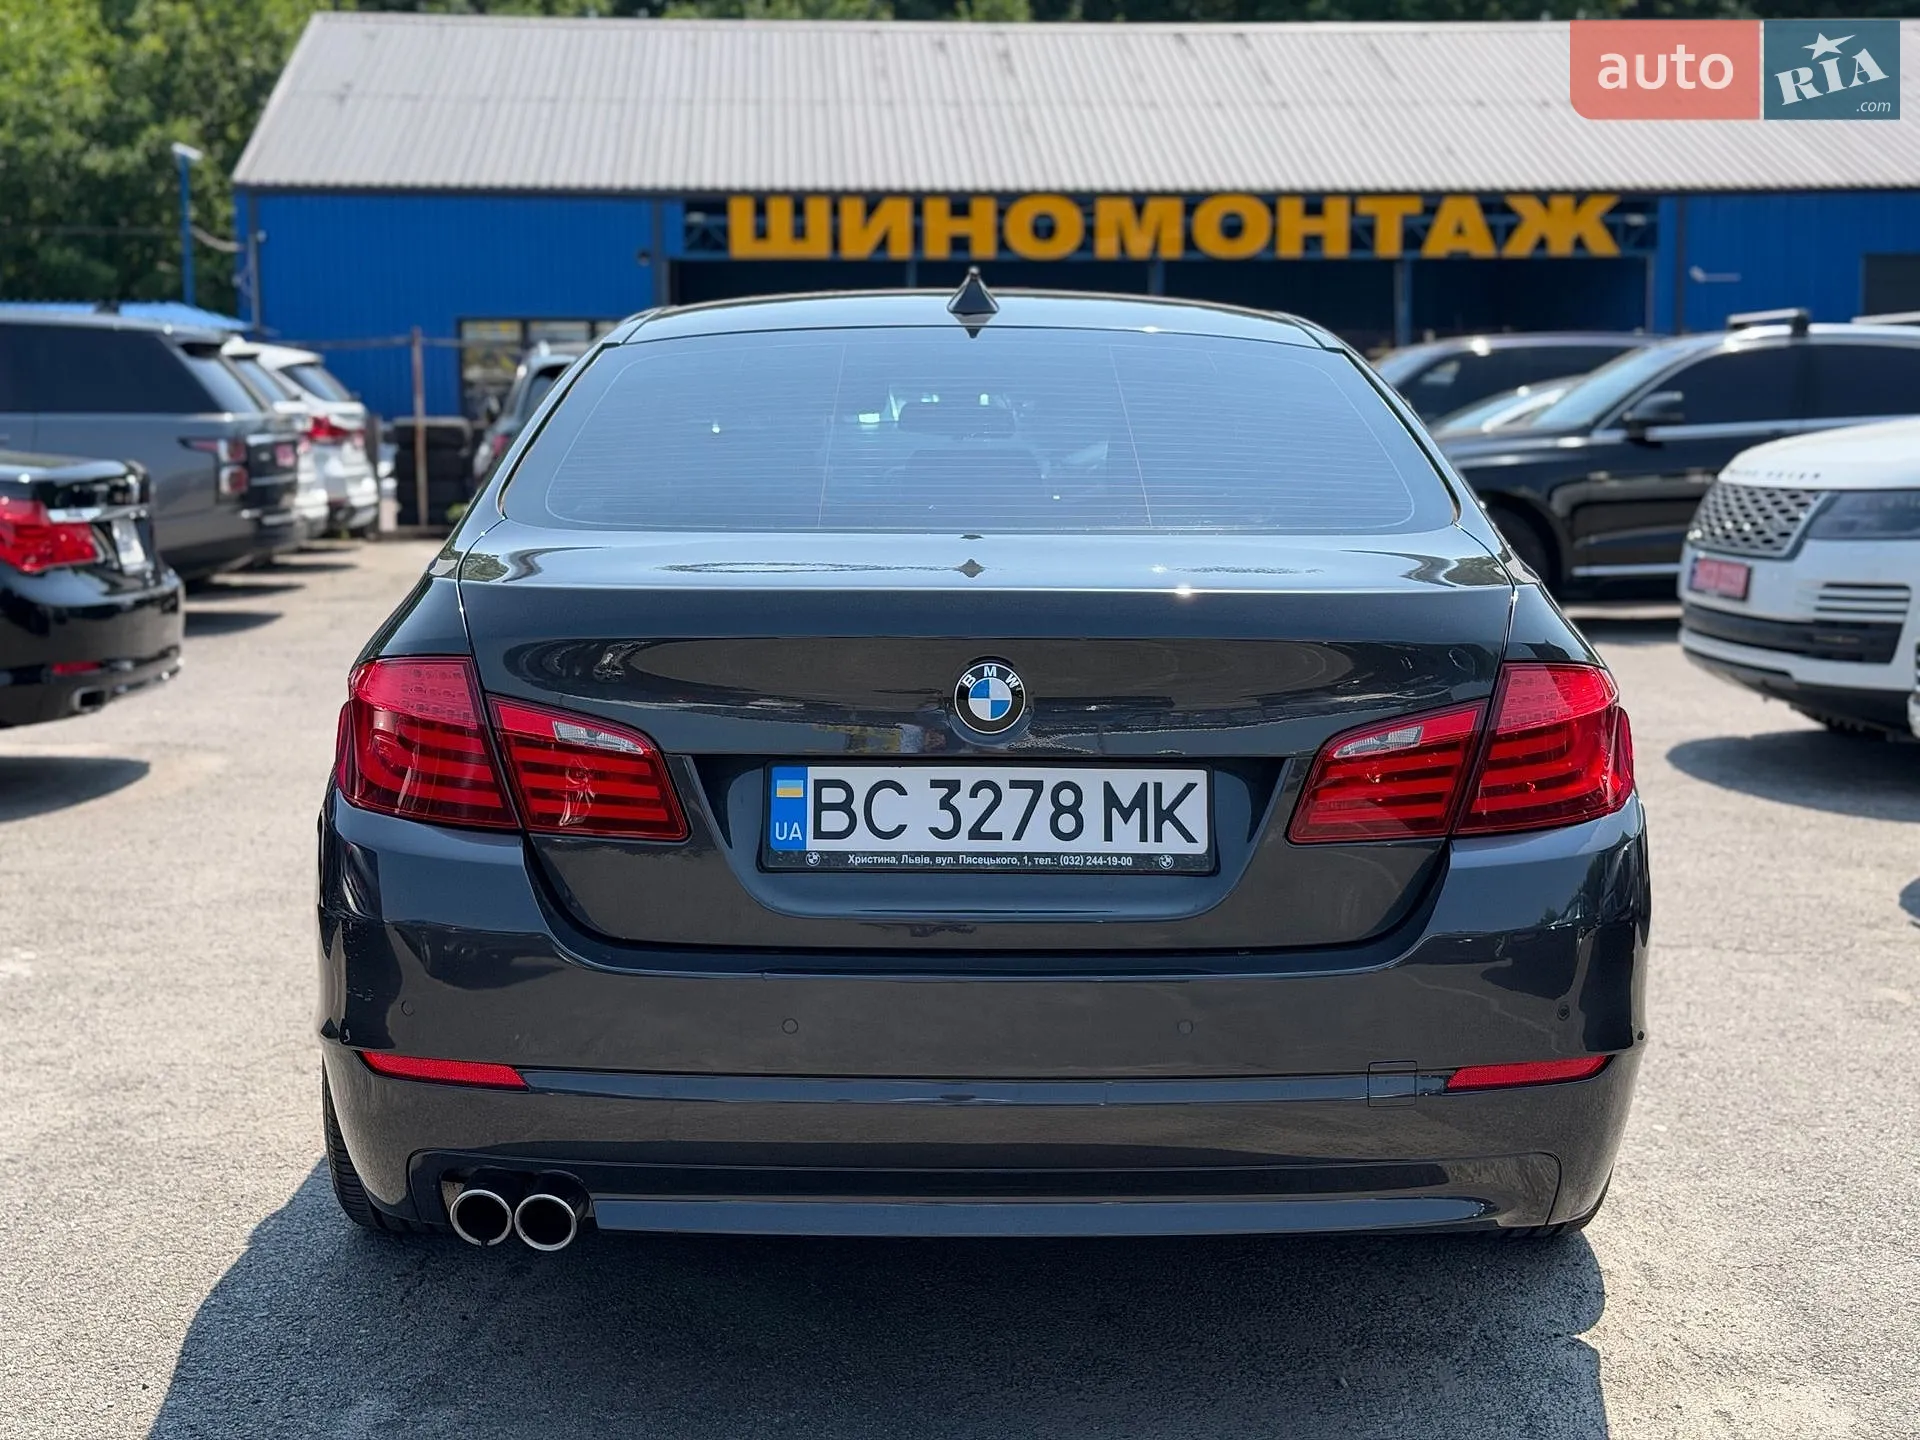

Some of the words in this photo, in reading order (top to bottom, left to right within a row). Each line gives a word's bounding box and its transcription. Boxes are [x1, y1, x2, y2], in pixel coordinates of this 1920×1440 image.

[728, 194, 1621, 260] ШИНОМОНТАЖ
[961, 665, 1020, 689] BMW
[812, 778, 908, 841] BC
[928, 779, 1085, 842] 3278
[1103, 781, 1199, 844] MK
[775, 822, 803, 841] UA
[847, 854, 899, 866] Христина,
[900, 854, 933, 866] Львів,
[935, 857, 956, 866] вул.
[959, 855, 1020, 867] Пясецького,
[1023, 855, 1032, 867] 1,
[1034, 857, 1058, 866] тел.:
[1060, 855, 1084, 867] (032)
[1086, 856, 1133, 866] 244-19-00
